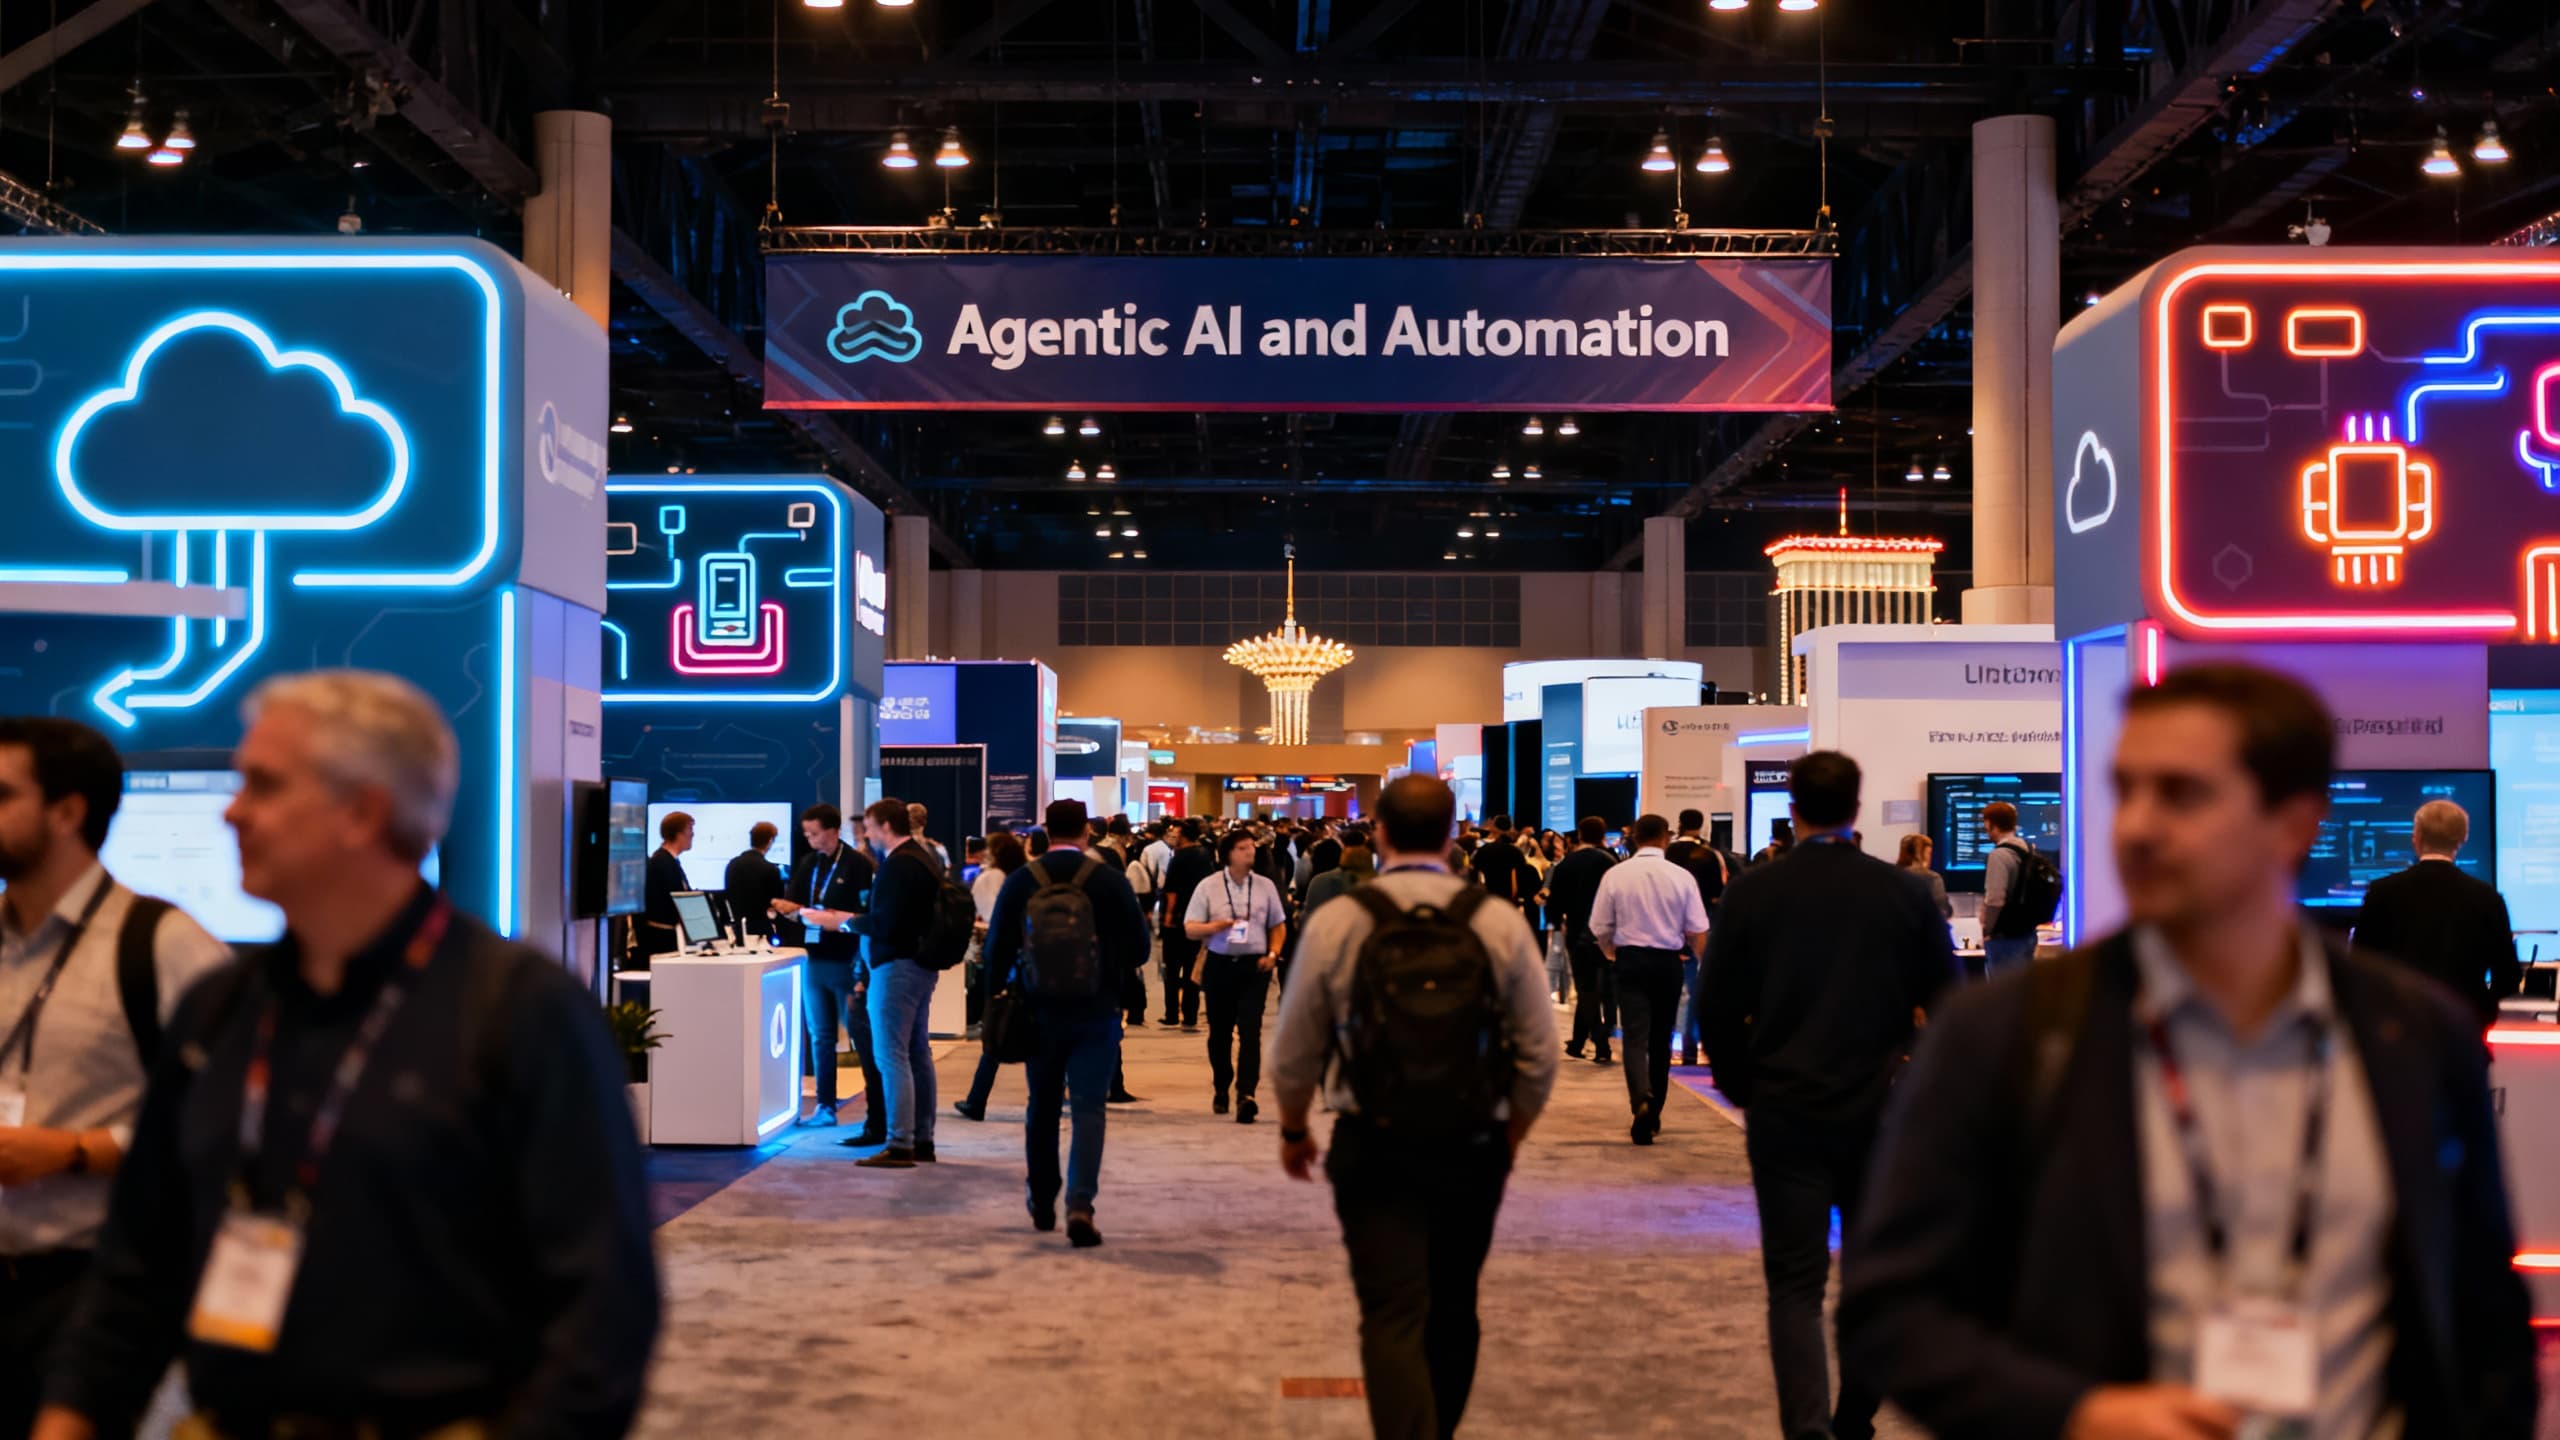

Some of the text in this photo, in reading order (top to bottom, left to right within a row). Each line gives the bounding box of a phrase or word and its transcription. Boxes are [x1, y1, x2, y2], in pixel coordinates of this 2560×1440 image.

[946, 303, 1728, 370] Agentic AI and Automation
